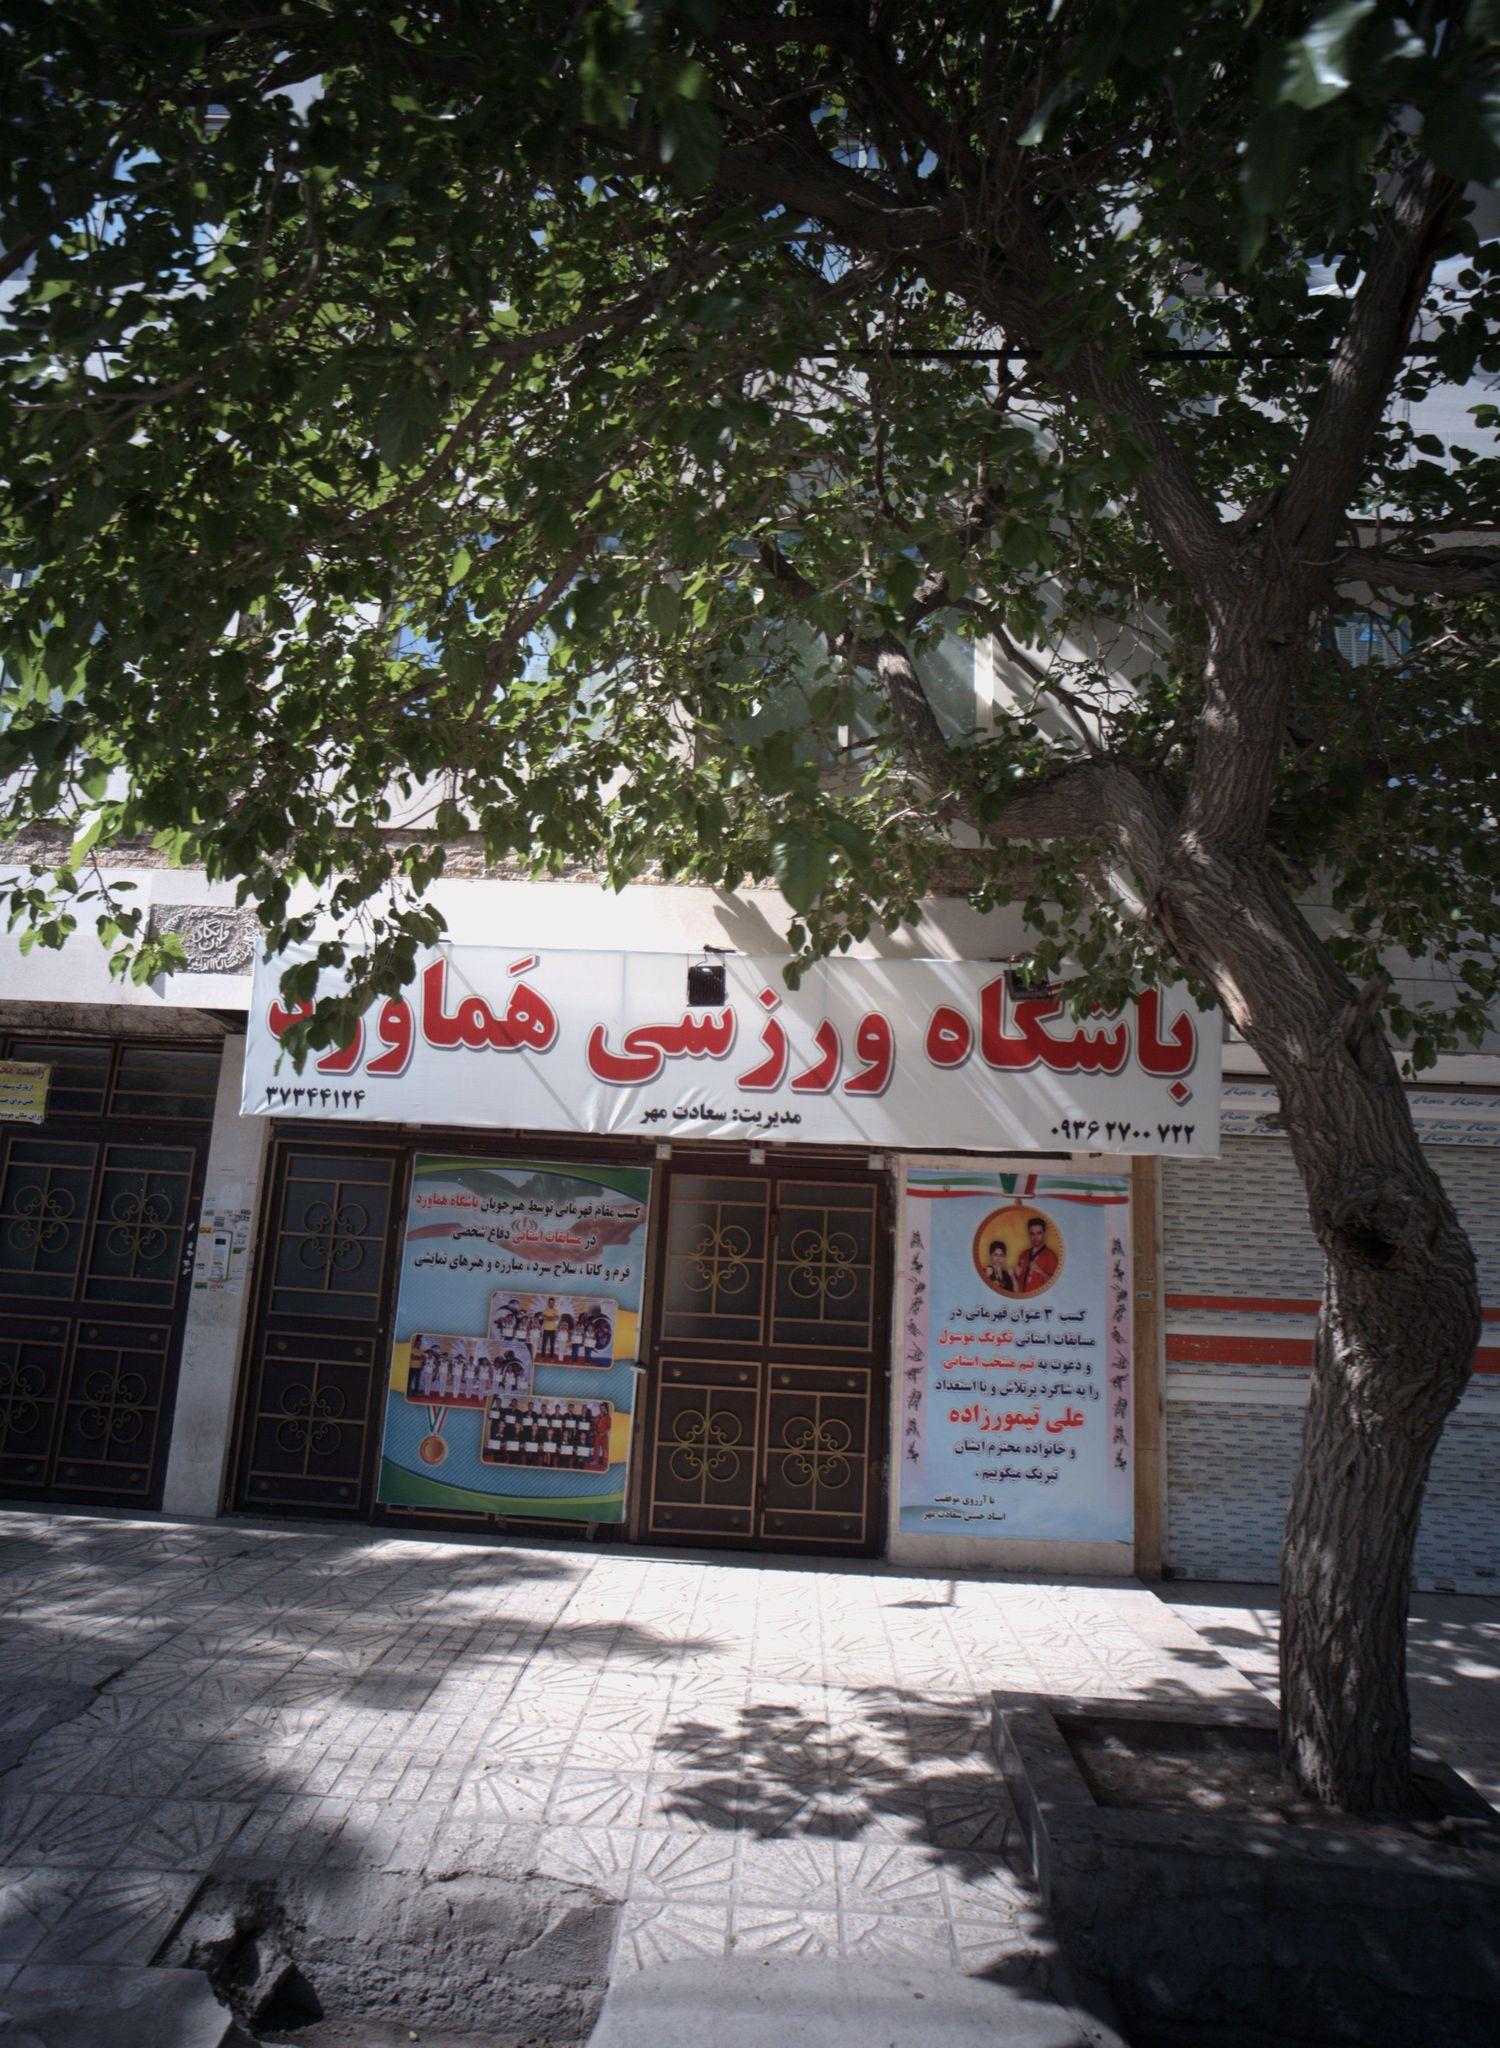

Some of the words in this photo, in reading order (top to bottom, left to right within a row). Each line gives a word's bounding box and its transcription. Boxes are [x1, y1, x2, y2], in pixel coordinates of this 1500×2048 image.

[265, 1086, 366, 1110] ۳۷۳۴۴۱۲۴
[640, 1107, 667, 1123] مهر
[673, 1104, 726, 1121] سعادت
[733, 1109, 801, 1128] مدیریت:
[415, 1191, 448, 1211] هماورد
[450, 1194, 478, 1211] باشگاه
[528, 1199, 554, 1217] توسط
[555, 1200, 592, 1219] قهرمانی
[595, 1203, 615, 1219] مقام
[617, 1206, 641, 1220] کسب
[453, 1225, 486, 1240] شخصی
[487, 1227, 510, 1243] دفاع
[512, 1228, 543, 1245] استانی
[545, 1230, 582, 1246] مسابقات
[584, 1235, 596, 1249] در
[415, 1252, 447, 1268] نمایشی
[486, 1262, 492, 1274] و
[495, 1260, 523, 1276] مبارزه
[533, 1262, 551, 1276] سرد
[554, 1260, 576, 1277] سلاح
[586, 1262, 602, 1276] کاتا
[604, 1270, 610, 1281] و
[613, 1265, 630, 1281] فرم
[949, 1307, 962, 1320] در
[966, 1306, 1007, 1322] قهرمانی
[1011, 1308, 1041, 1323] عنوان
[1044, 1309, 1053, 1320] ۳
[1059, 1308, 1086, 1322] کسب
[1016, 1332, 1051, 1348] استانی
[1053, 1333, 1096, 1348] مسابقات
[943, 1355, 978, 1370] استانی
[982, 1358, 1015, 1371] منتخب
[1019, 1359, 1035, 1371] تیم
[1038, 1360, 1048, 1372] به
[1051, 1360, 1081, 1374] دعوت
[1086, 1365, 1092, 1375] و
[935, 1378, 976, 1392] استعداد
[991, 1384, 997, 1396] و
[1040, 1381, 1072, 1398] شاگرد
[1075, 1384, 1086, 1397] به
[1090, 1385, 1100, 1400] را
[949, 1404, 1040, 1431] تیمورزاده
[1046, 1407, 1084, 1433] علی
[955, 1440, 985, 1454] ایشان
[988, 1441, 1022, 1457] محترم
[1025, 1442, 1066, 1458] خانواده
[1070, 1448, 1076, 1459] و
[1026, 1467, 1058, 1484] تبریک
